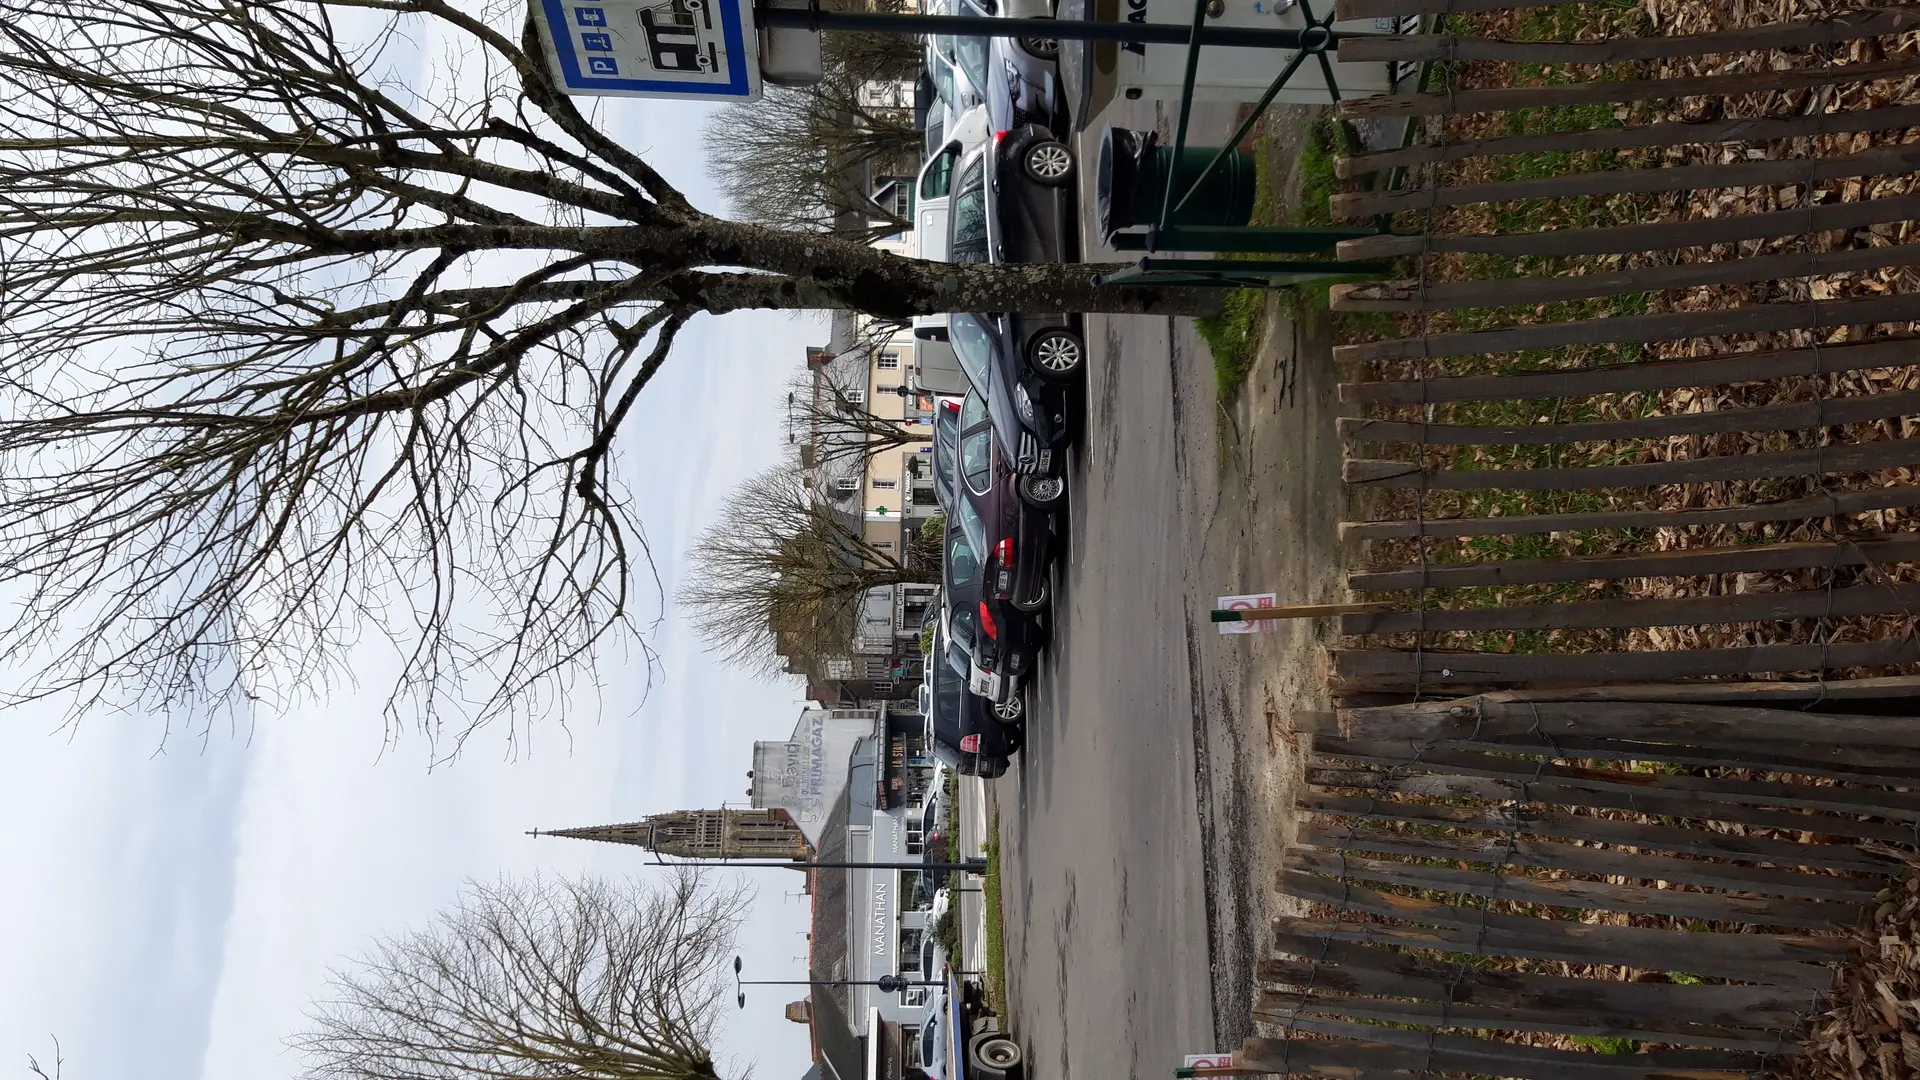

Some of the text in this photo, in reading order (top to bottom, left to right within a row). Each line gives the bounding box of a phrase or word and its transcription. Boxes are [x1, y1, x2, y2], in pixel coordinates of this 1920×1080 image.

[594, 60, 614, 71] P
[810, 716, 824, 795] PRIMAGAZ
[892, 816, 900, 854] MANATHAN
[874, 883, 887, 956] MANATHAN
